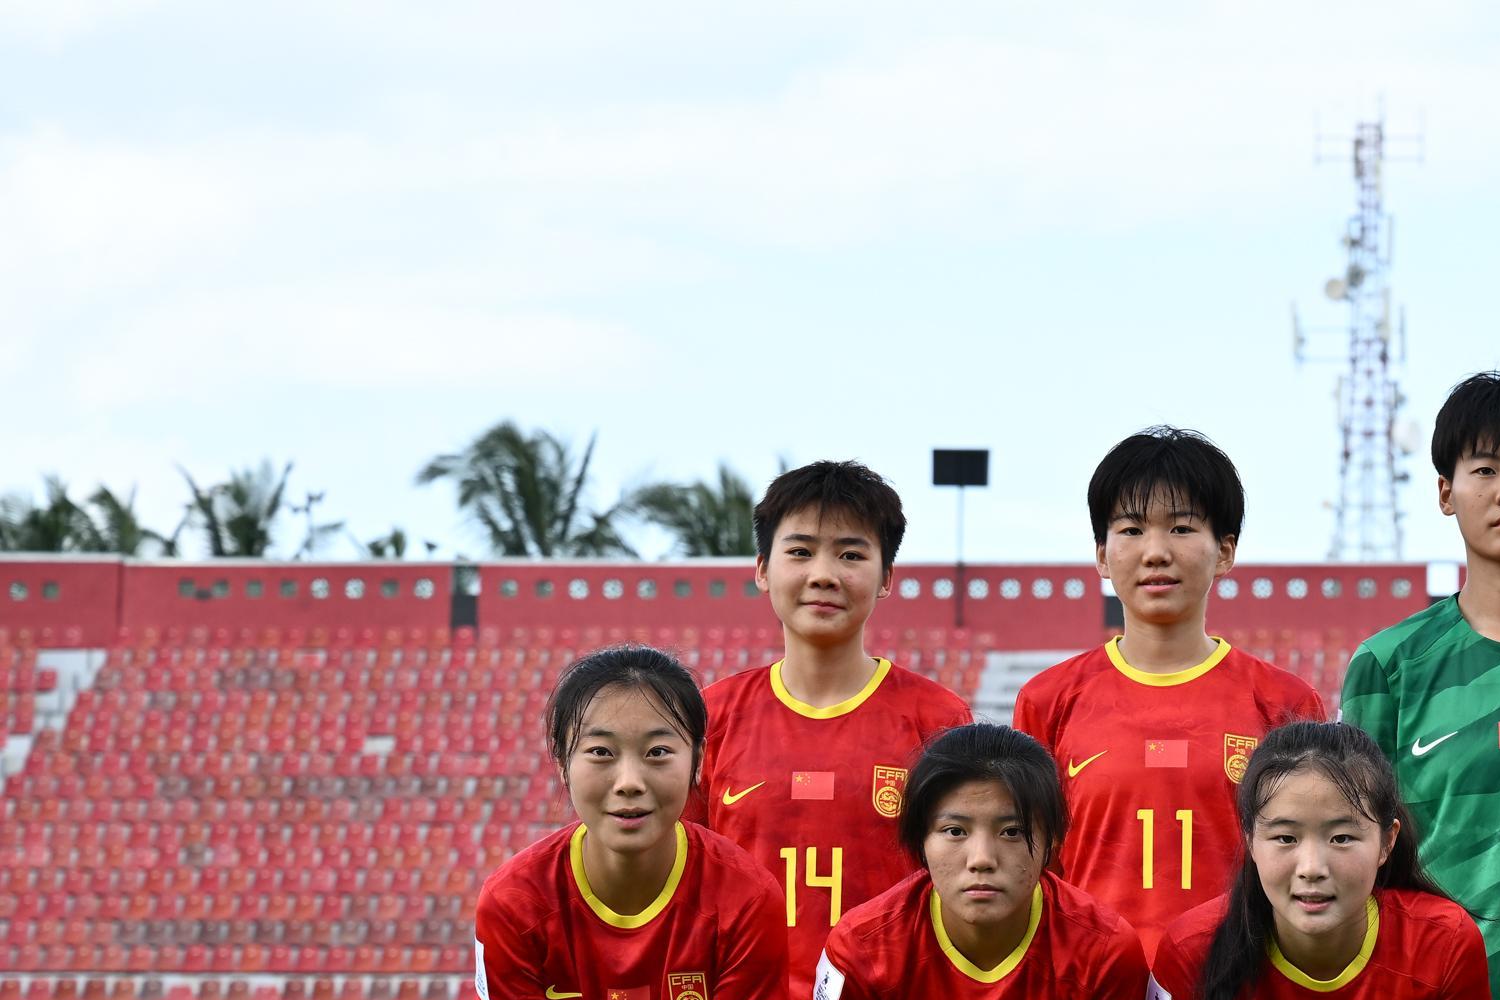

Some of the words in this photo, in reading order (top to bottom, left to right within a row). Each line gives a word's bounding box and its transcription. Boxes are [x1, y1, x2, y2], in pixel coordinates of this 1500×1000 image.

[1227, 738, 1255, 749] CFA
[876, 769, 905, 781] CFA
[1137, 809, 1192, 889] 11
[781, 847, 842, 926] 14
[671, 975, 703, 986] CFA
